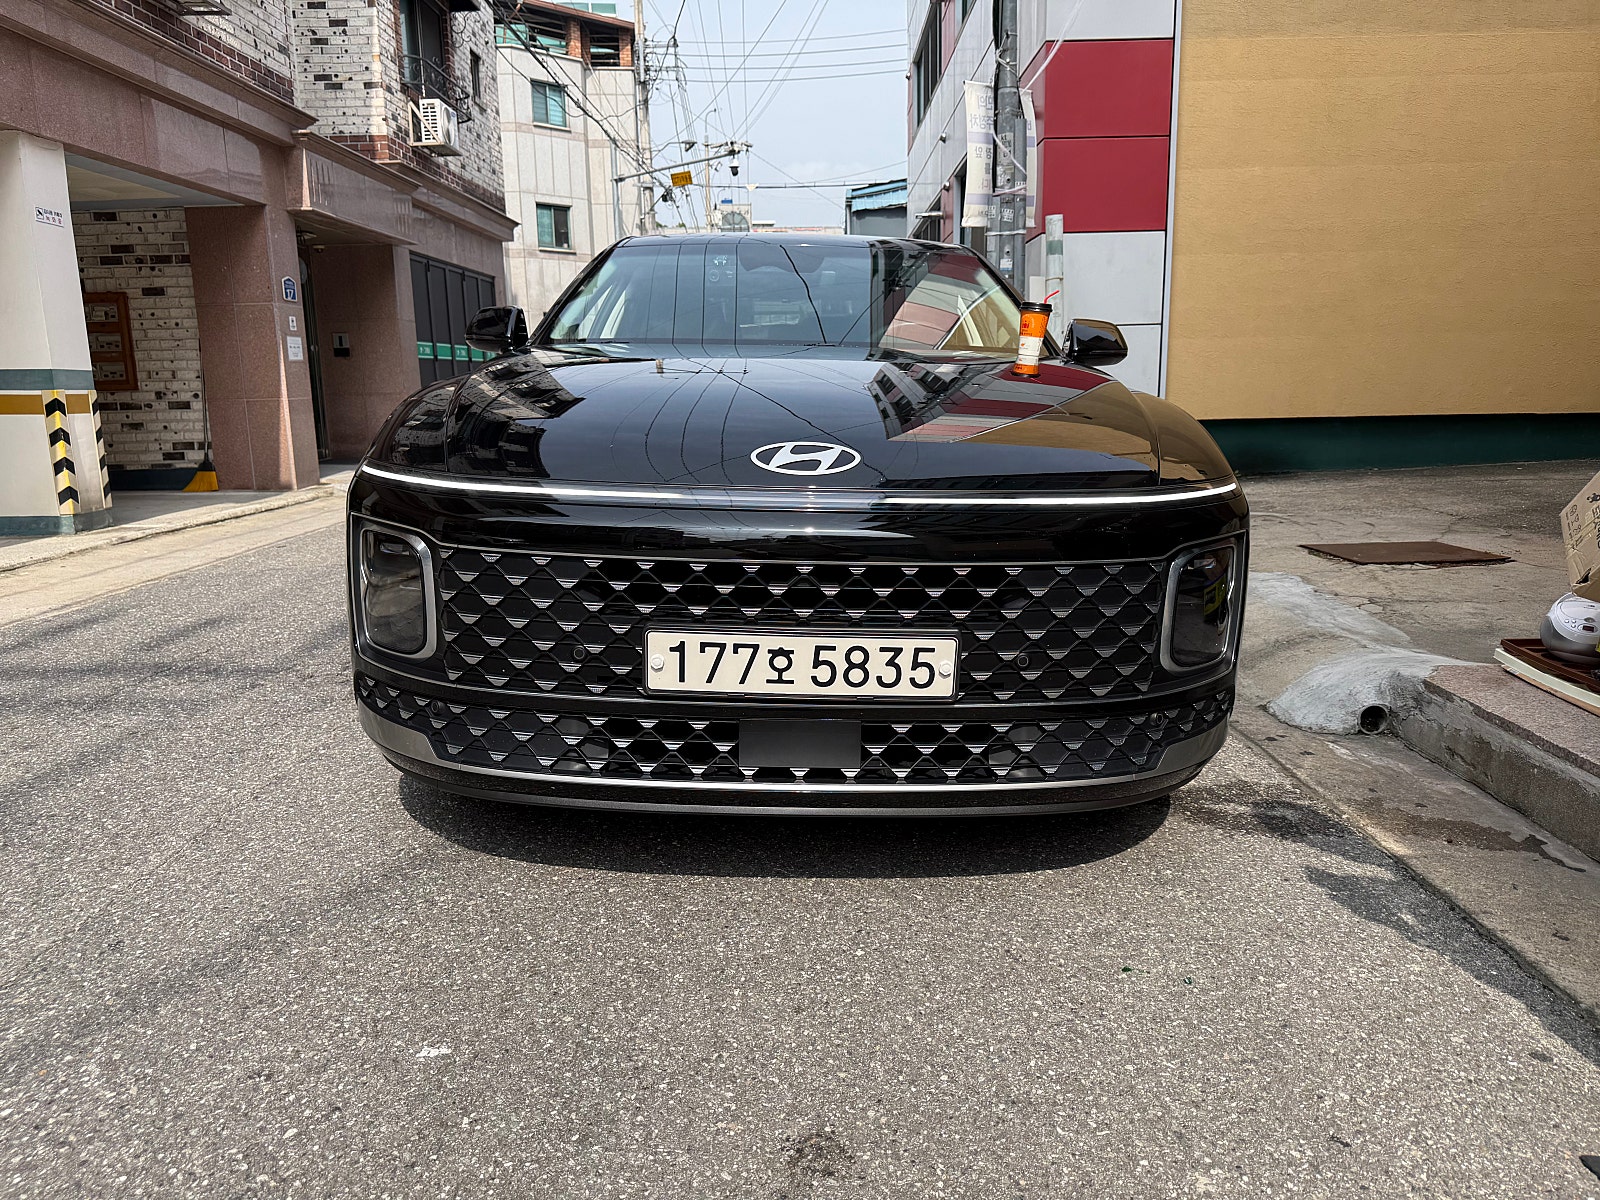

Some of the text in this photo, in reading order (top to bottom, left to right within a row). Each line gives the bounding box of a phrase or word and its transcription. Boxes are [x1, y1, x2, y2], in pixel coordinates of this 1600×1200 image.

[286, 289, 294, 299] 17
[669, 640, 936, 689] 177호 5835
